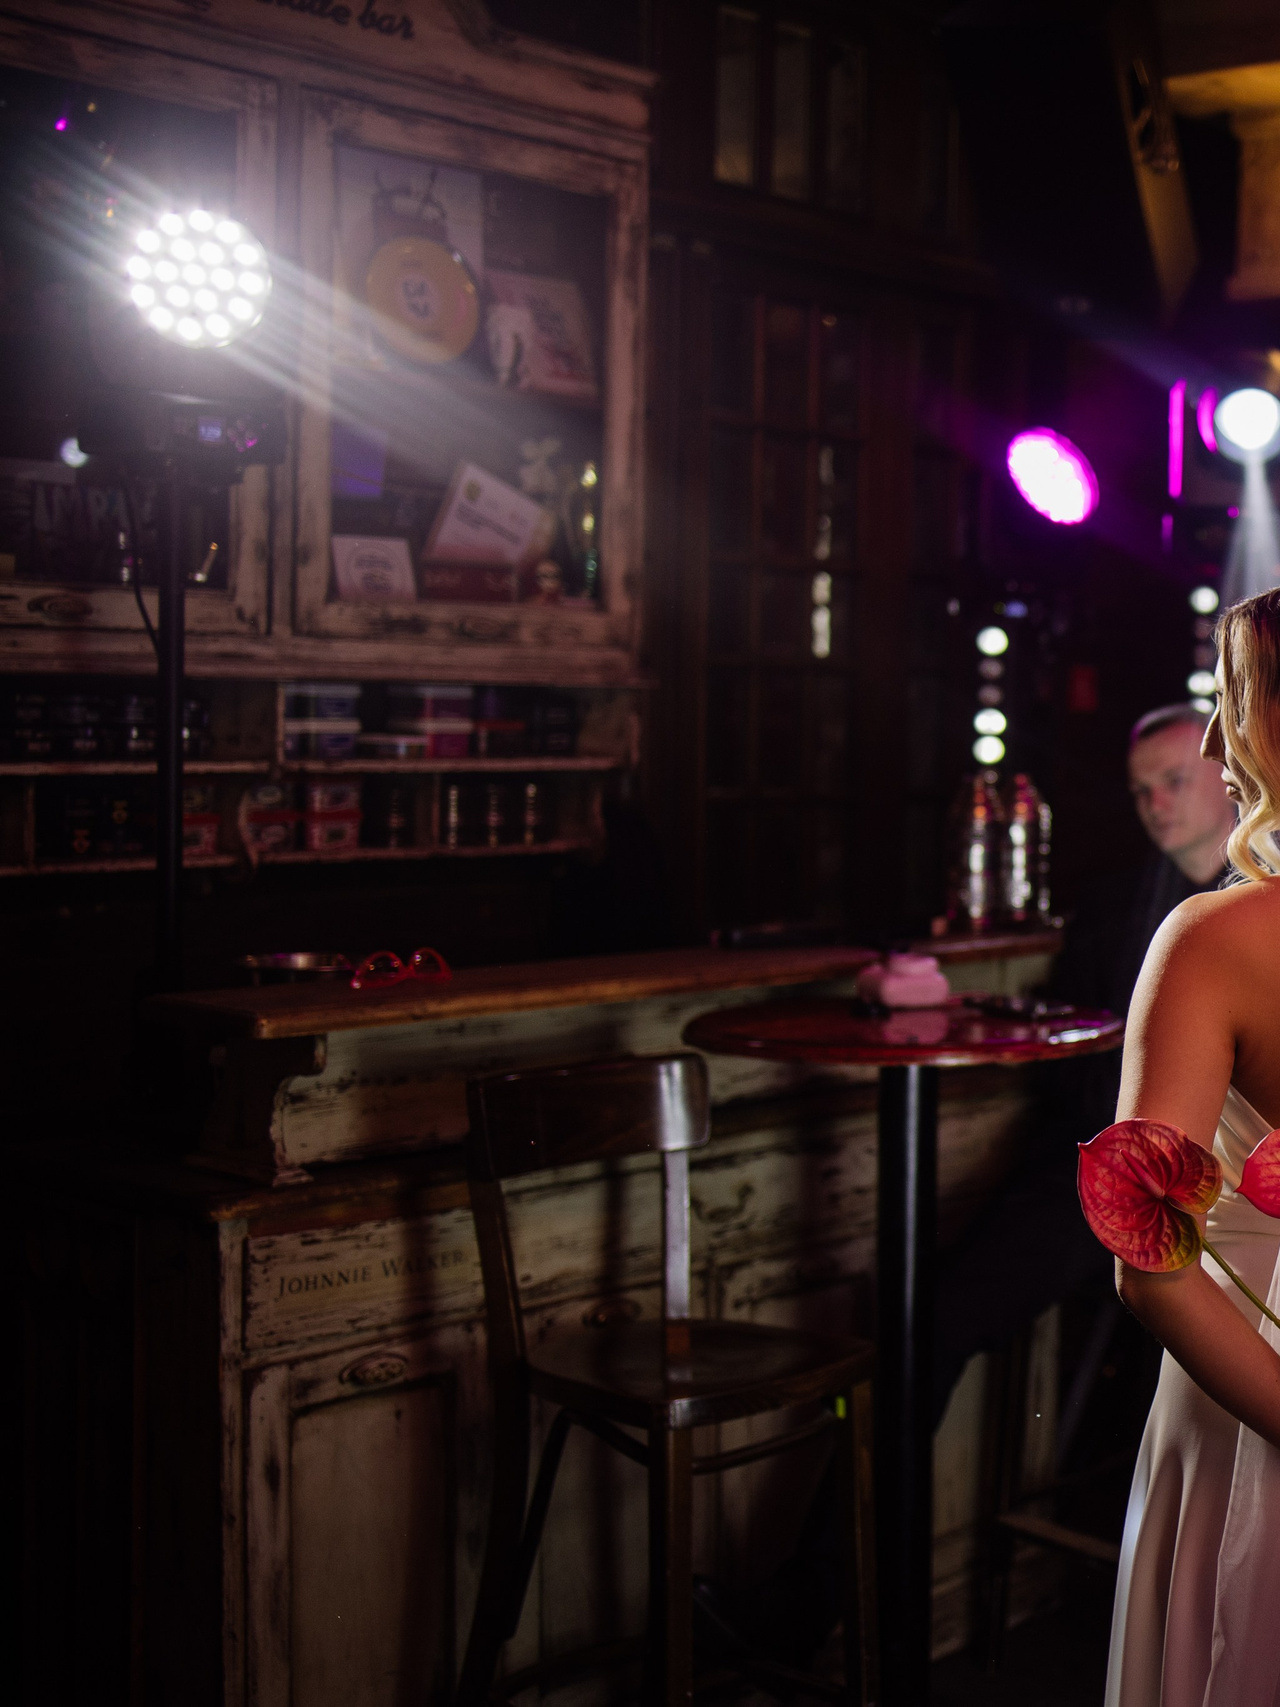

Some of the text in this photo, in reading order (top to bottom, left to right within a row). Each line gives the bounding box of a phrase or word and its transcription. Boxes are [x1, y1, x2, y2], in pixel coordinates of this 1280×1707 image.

[358, 0, 414, 39] bar
[277, 1250, 464, 1297] JOHNNIE WALKER
